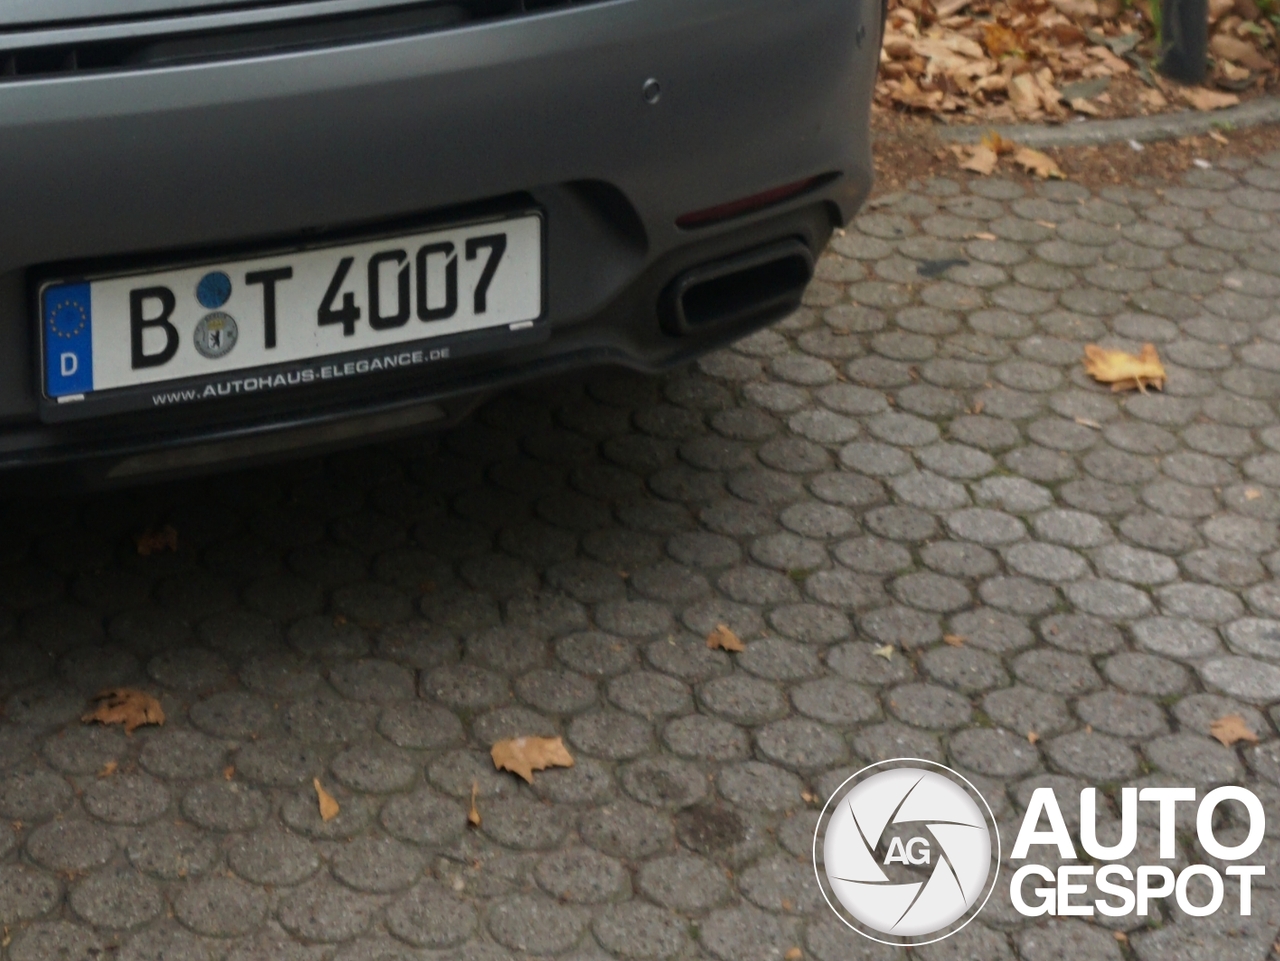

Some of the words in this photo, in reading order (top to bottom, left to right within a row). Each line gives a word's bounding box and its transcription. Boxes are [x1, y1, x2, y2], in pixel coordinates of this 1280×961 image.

[129, 285, 181, 372] B
[244, 266, 294, 351] T
[317, 233, 508, 337] 4007
[60, 351, 79, 378] D
